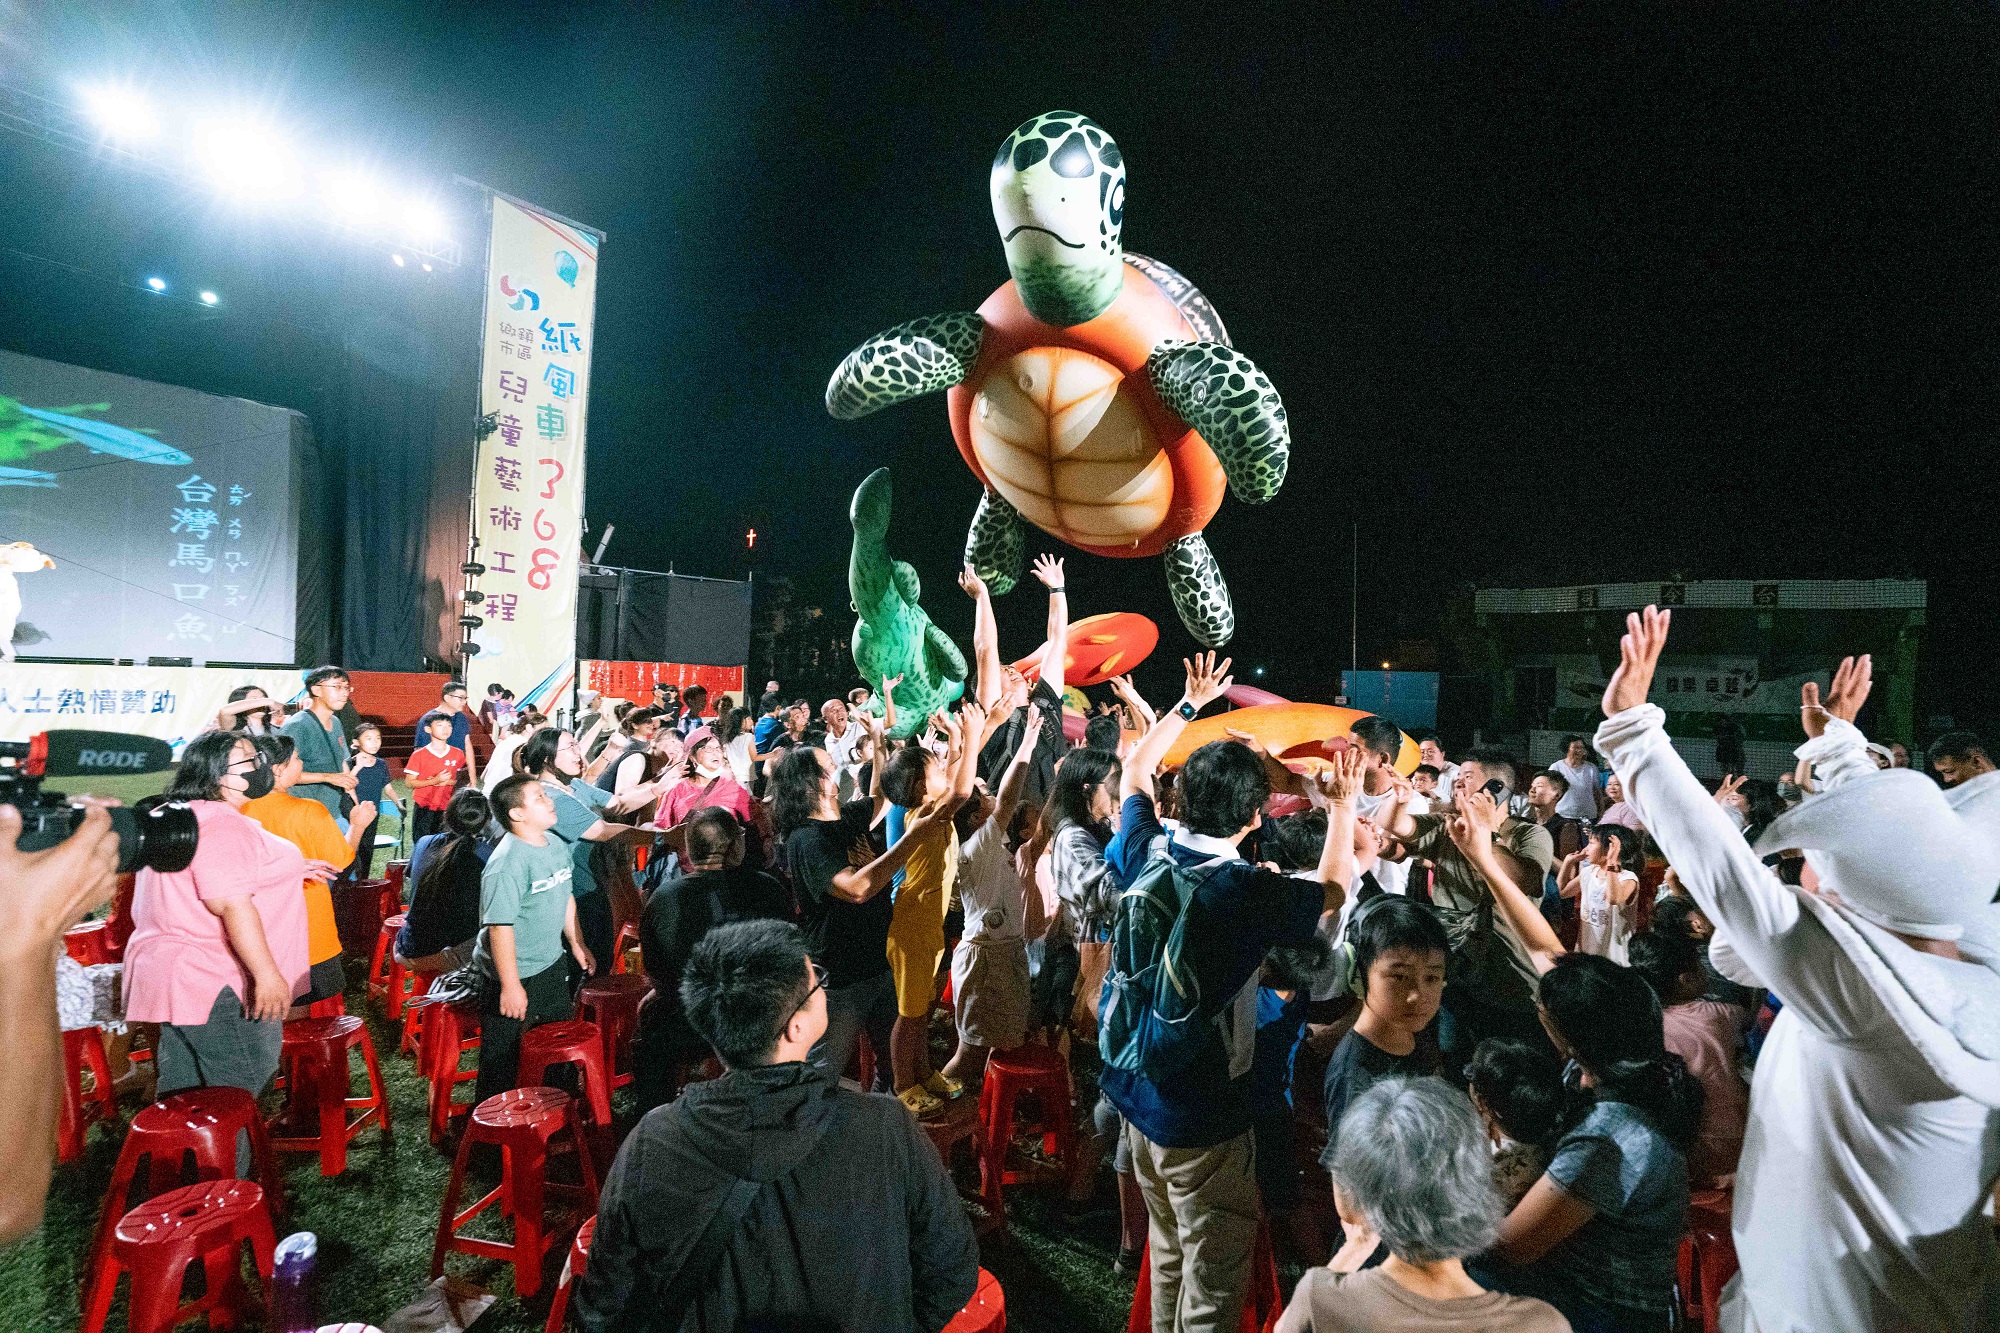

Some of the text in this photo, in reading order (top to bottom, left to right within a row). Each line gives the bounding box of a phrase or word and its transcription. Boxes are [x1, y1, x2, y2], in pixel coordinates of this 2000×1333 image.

[166, 474, 220, 642] 台灣馬口魚
[485, 369, 528, 622] 兒童藝術工程
[527, 317, 583, 590] 紙風車368
